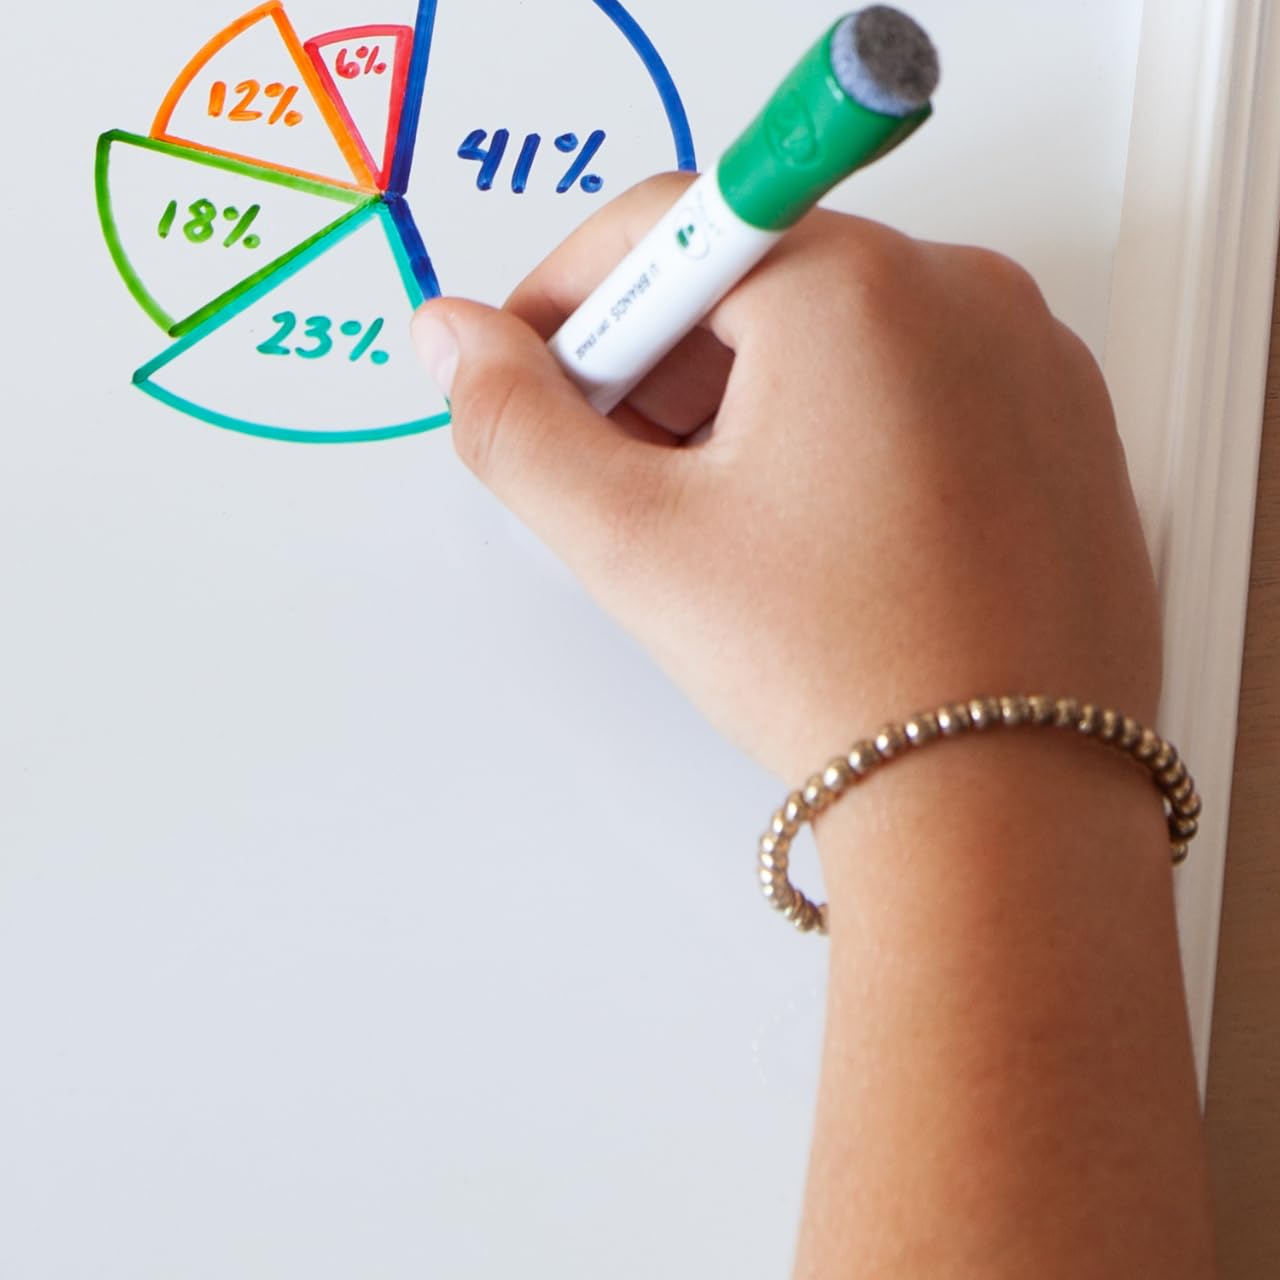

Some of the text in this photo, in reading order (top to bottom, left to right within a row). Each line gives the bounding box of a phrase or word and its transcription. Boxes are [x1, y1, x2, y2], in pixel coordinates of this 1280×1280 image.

[335, 46, 386, 79] 6%
[208, 80, 304, 127] 12%
[457, 128, 606, 193] 41%
[158, 199, 260, 249] 18%
[256, 310, 389, 365] 23%
